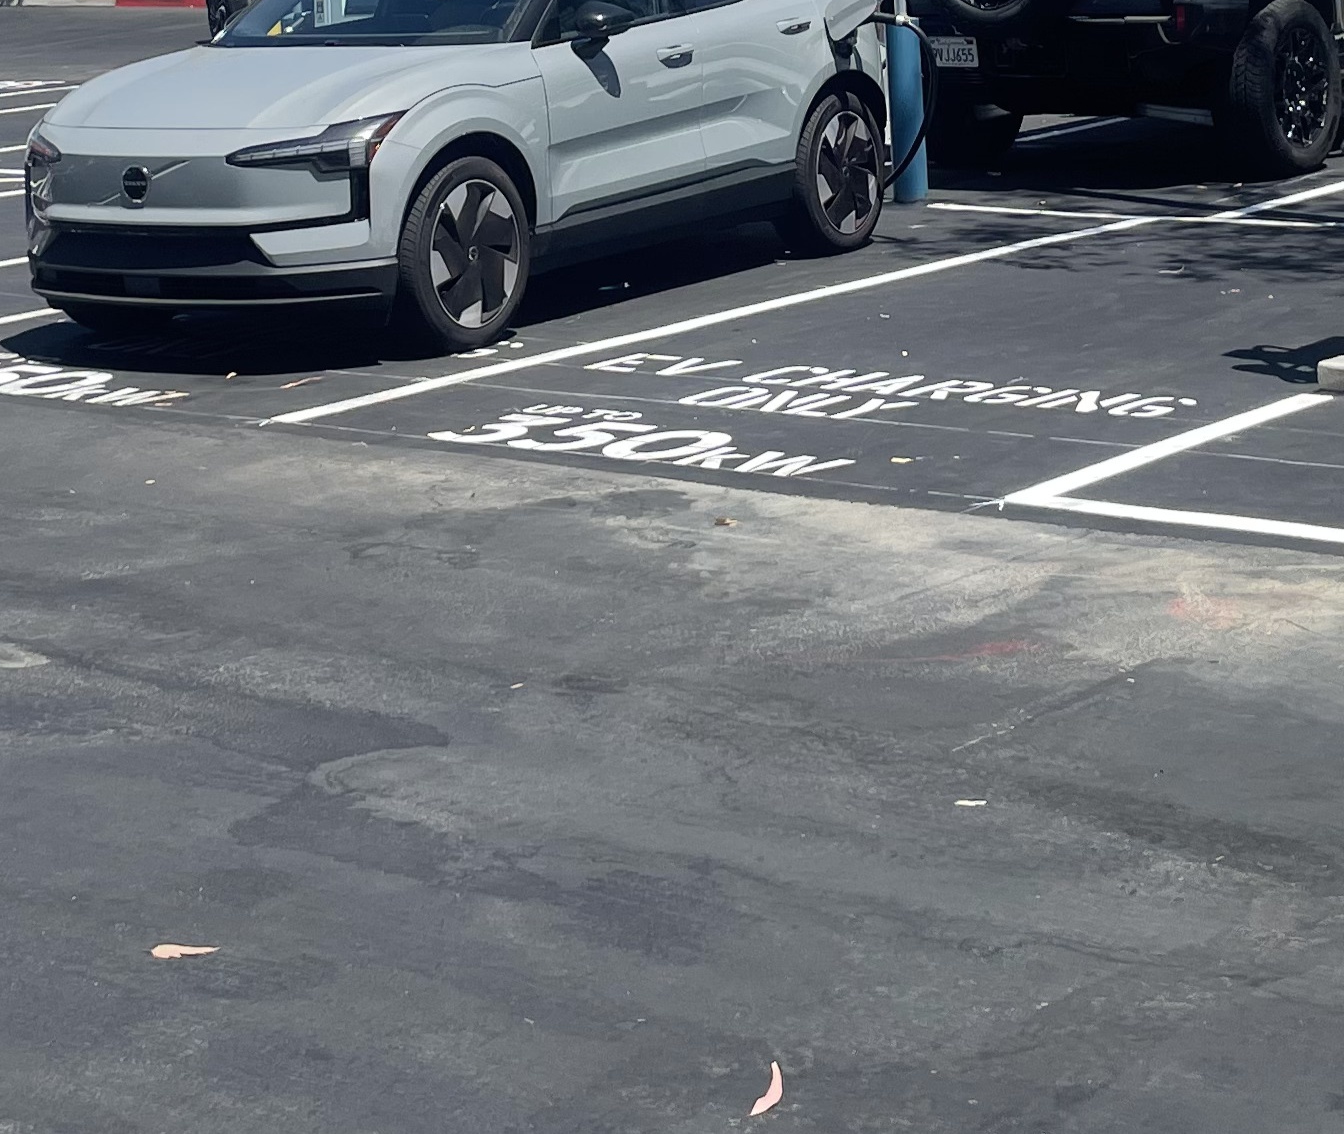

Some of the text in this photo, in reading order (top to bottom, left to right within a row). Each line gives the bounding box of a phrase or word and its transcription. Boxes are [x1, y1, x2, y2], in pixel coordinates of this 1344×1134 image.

[583, 353, 1198, 418] EV CHARGING
[678, 385, 920, 419] ONLY
[522, 403, 643, 420] UP TO
[427, 412, 856, 478] 350kW
